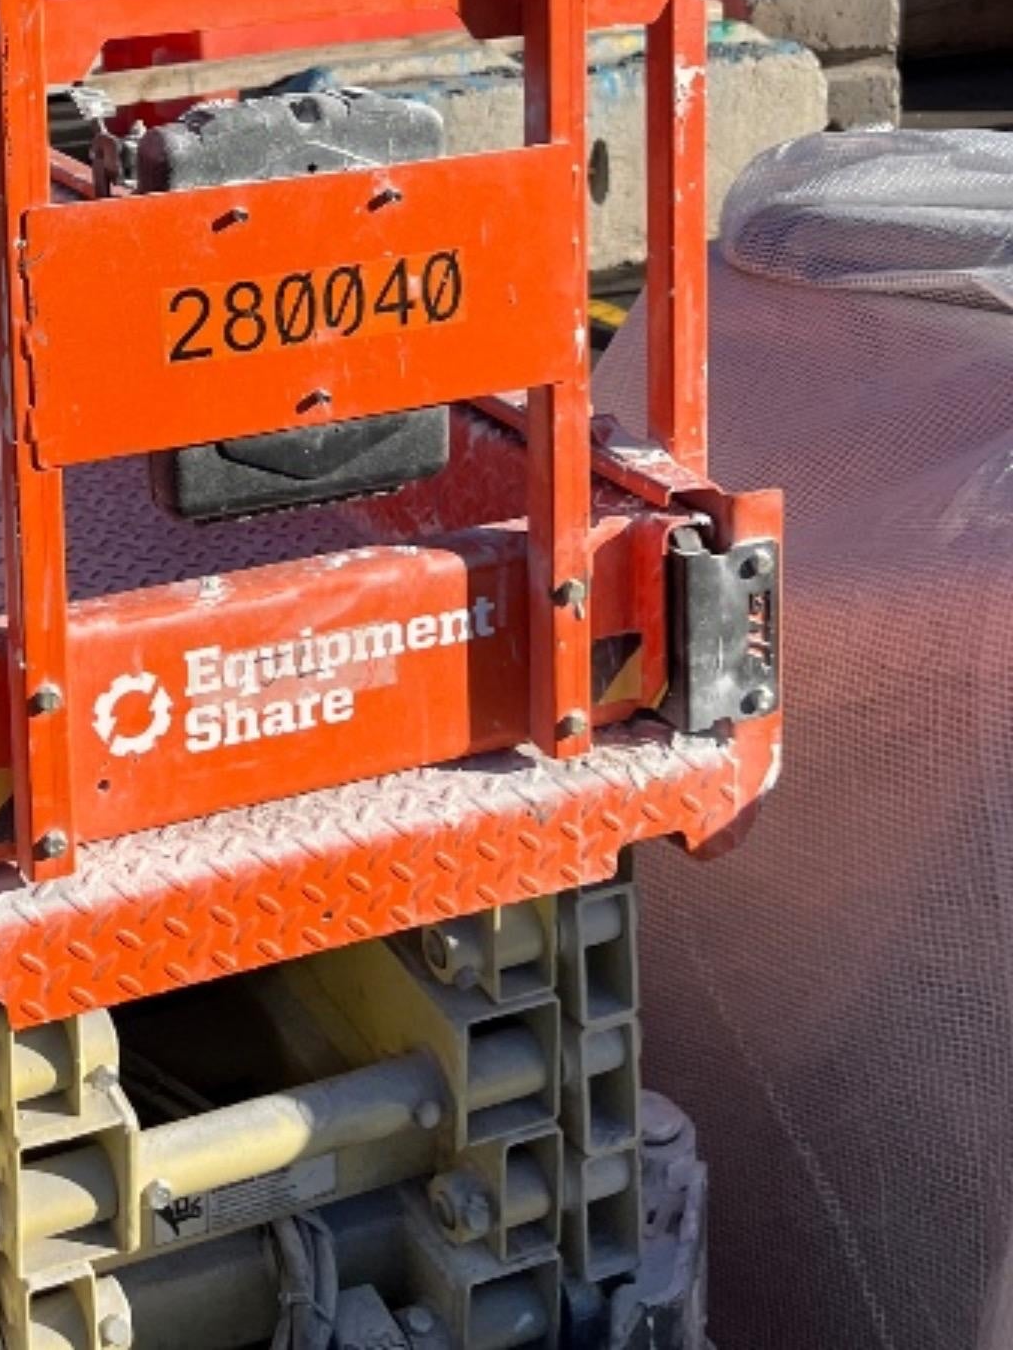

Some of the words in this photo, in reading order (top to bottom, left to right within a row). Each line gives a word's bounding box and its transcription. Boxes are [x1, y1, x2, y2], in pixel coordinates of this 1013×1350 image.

[169, 249, 462, 363] 280040
[183, 595, 496, 696] Equipment
[183, 686, 356, 754] Share
